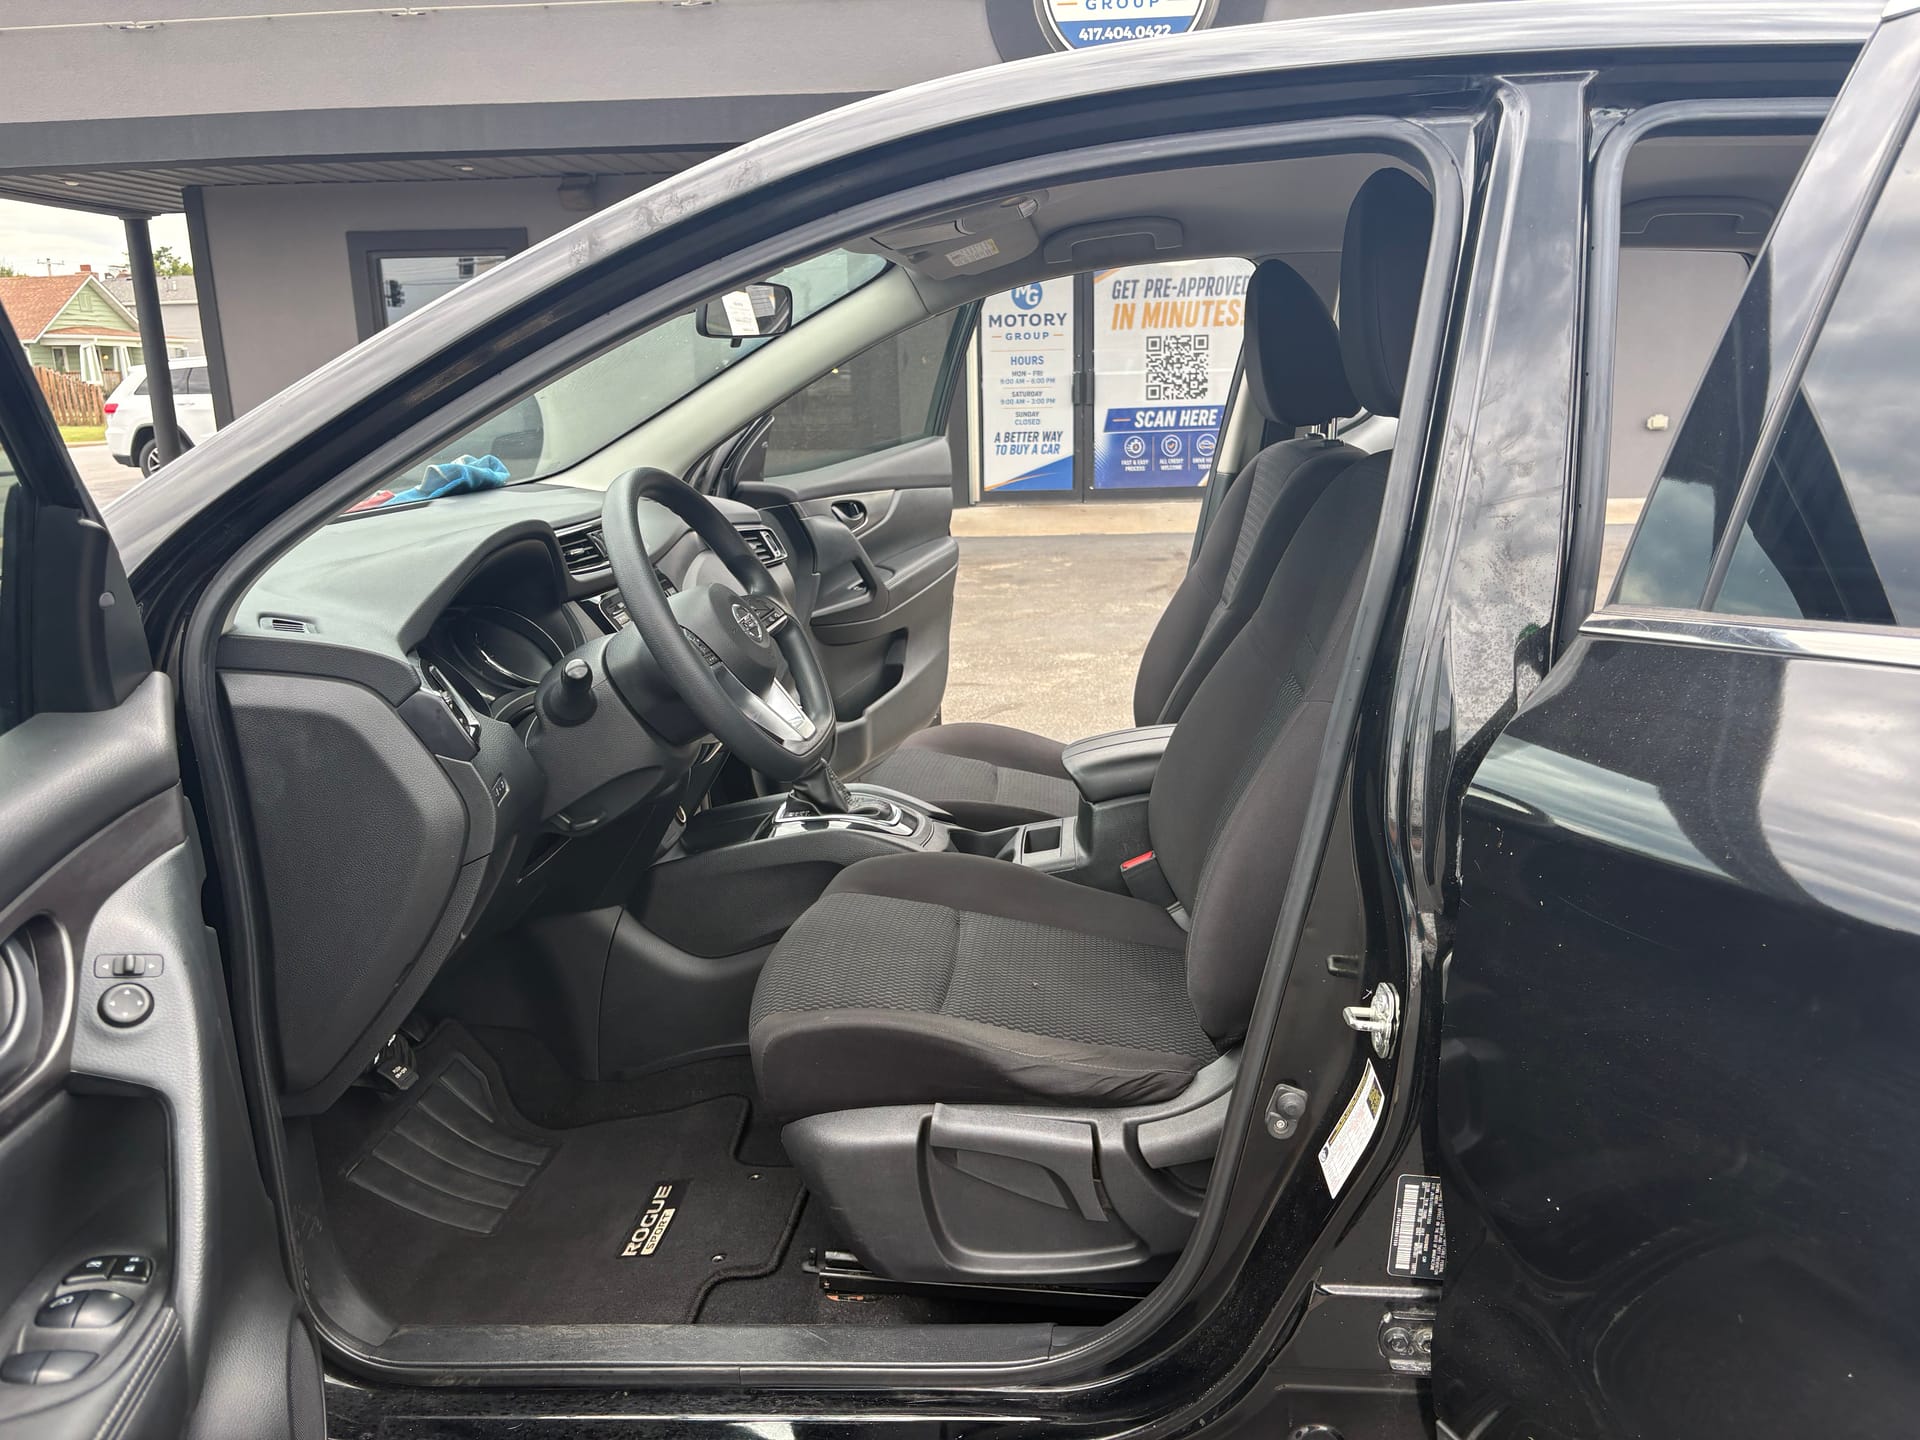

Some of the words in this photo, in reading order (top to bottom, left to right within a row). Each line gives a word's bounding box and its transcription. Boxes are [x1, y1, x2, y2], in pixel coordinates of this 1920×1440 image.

[1085, 0, 1160, 10] GROUP
[1078, 24, 1172, 41] 417.404.0422
[1111, 279, 1140, 300] GET
[988, 312, 1067, 328] MOTORY
[1111, 302, 1136, 331] IN
[1005, 331, 1049, 341] GROUP
[1010, 355, 1044, 366] HOURS
[1014, 418, 1041, 426] CLOSED
[1134, 410, 1177, 428] SCAN
[1179, 408, 1218, 427] HERE
[993, 431, 1001, 443] A
[1003, 431, 1040, 443] BETTER
[1042, 430, 1064, 443] WAY
[995, 444, 1007, 456] TO
[1009, 444, 1030, 455] BUY
[1031, 443, 1038, 455] A
[1040, 443, 1061, 455] CAR
[620, 1185, 673, 1257] ROGUE
[646, 1213, 671, 1249] SPORT
